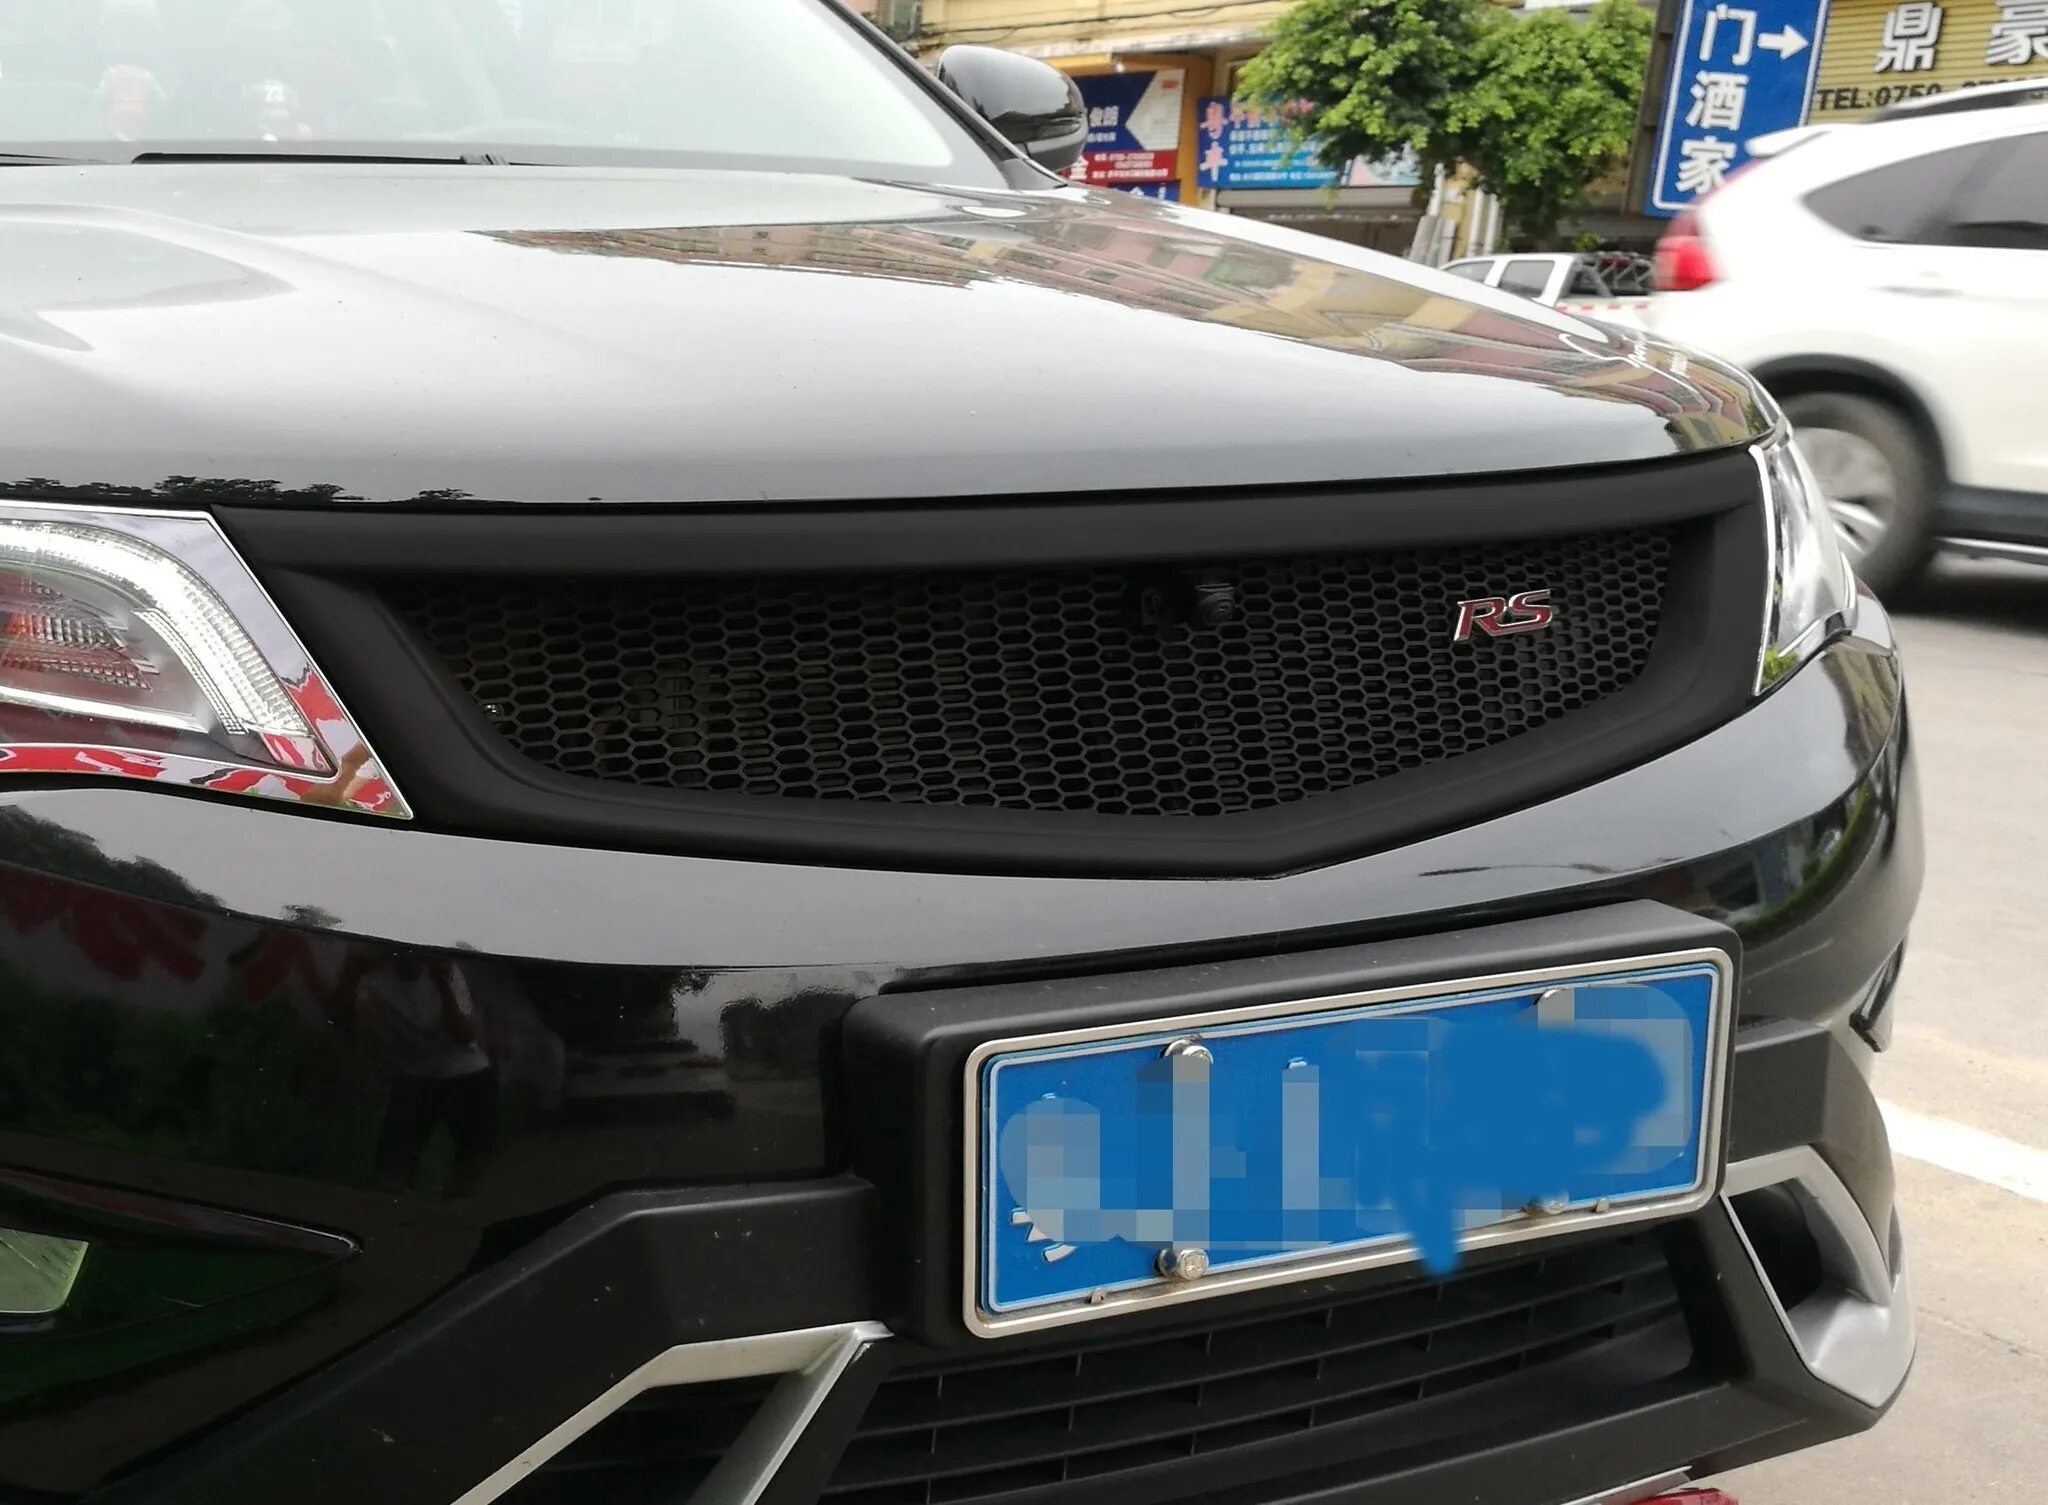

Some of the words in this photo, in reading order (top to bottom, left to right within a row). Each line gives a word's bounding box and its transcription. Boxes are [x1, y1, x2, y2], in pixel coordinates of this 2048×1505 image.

[1674, 4, 1758, 194] 门酒家
[1453, 588, 1553, 642] RS
